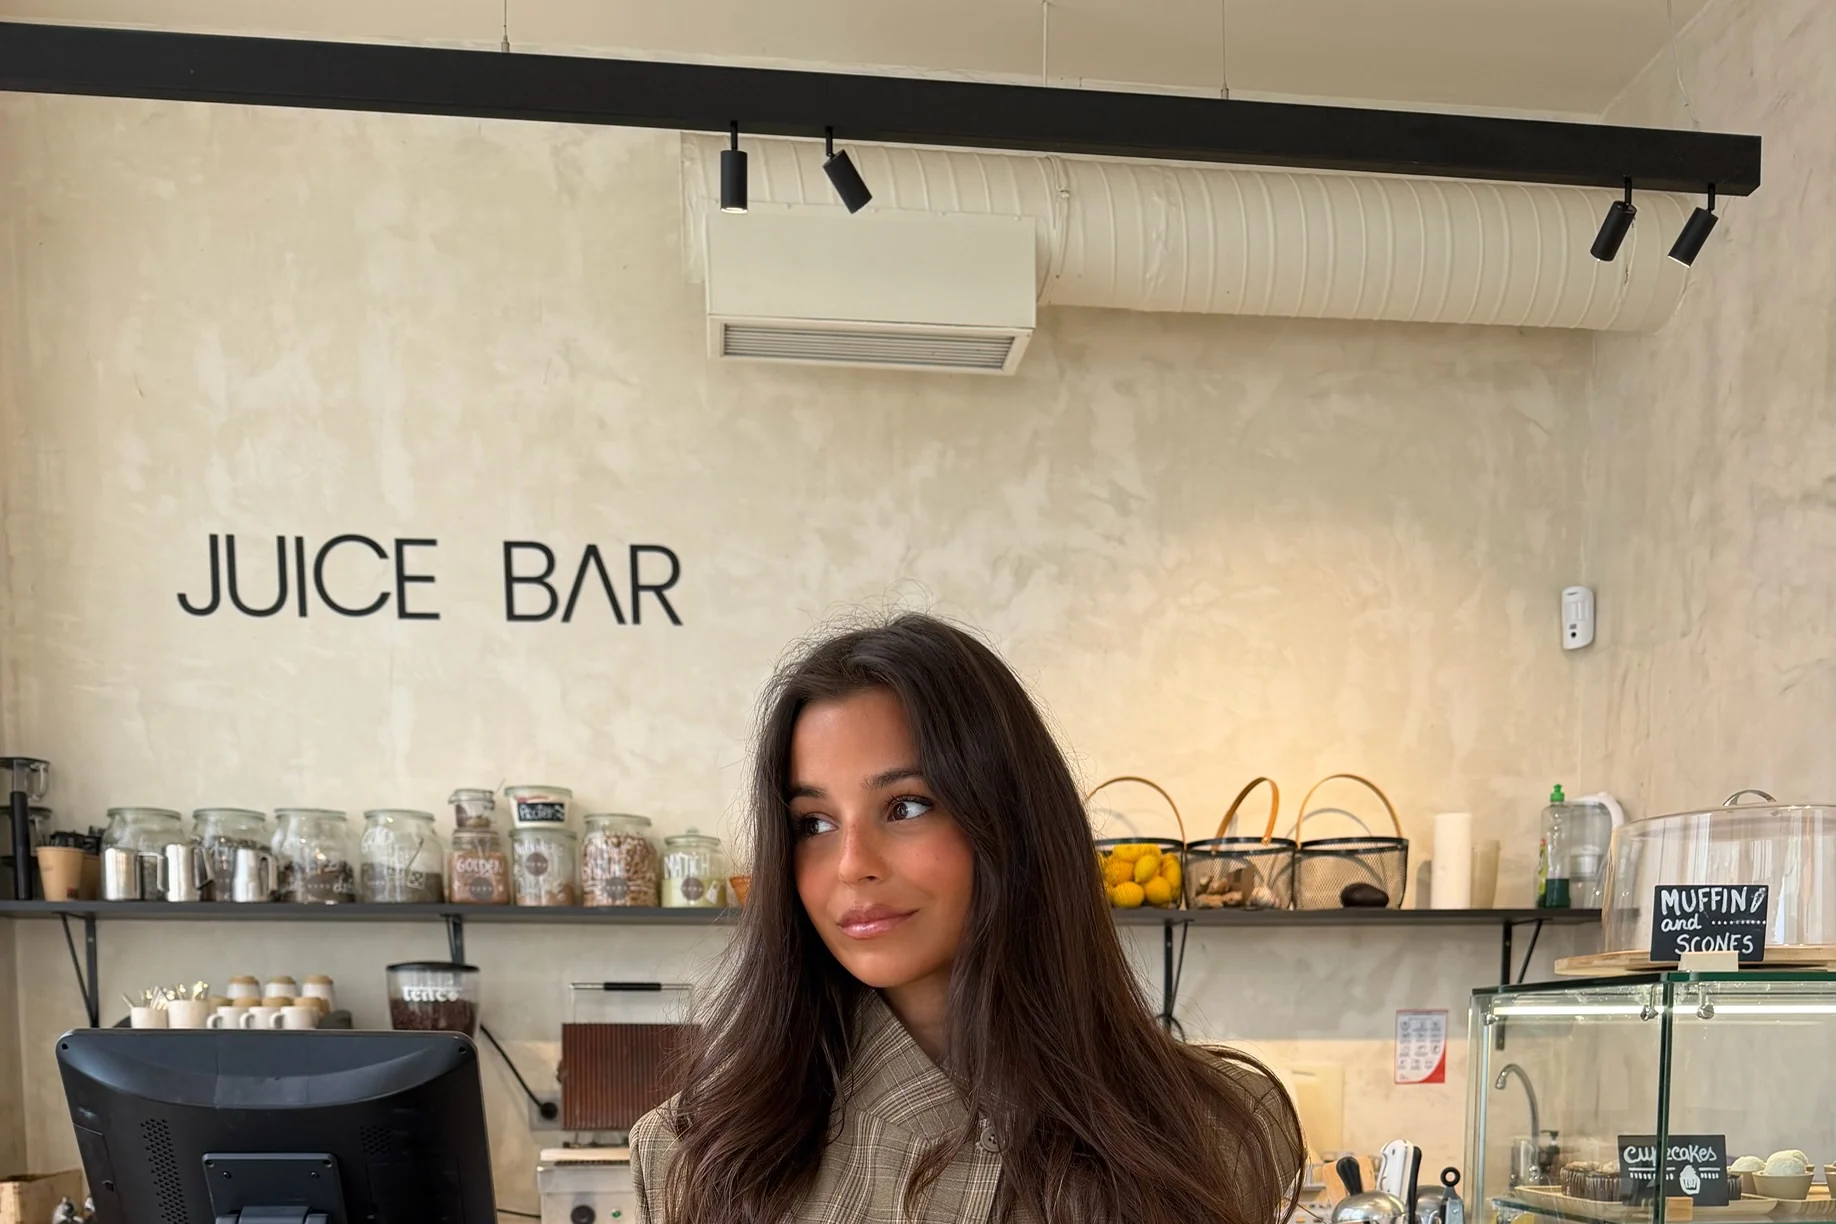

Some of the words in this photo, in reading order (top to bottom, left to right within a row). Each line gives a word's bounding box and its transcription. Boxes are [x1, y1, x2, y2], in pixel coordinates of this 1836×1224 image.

[176, 533, 441, 620] JUICE
[502, 540, 684, 626] BAR
[1660, 912, 1703, 932] and
[1674, 932, 1754, 954] SCONES
